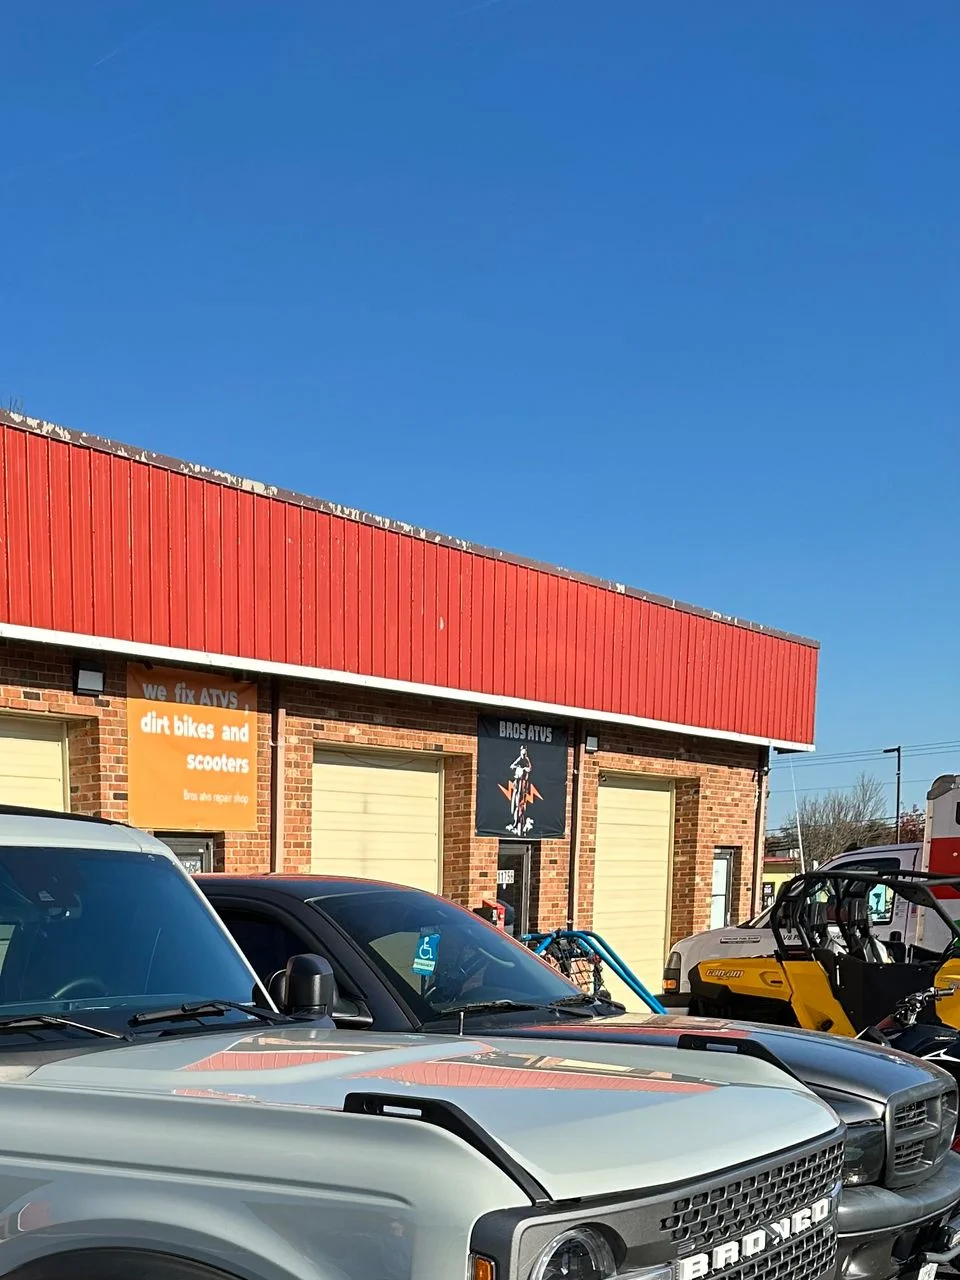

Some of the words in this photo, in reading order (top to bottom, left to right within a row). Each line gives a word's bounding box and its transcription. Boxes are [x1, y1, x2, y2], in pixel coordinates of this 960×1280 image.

[142, 682, 167, 701] we
[174, 681, 196, 705] fix
[140, 710, 170, 736] dirt
[173, 714, 215, 740] bikes
[221, 722, 249, 743] and
[499, 720, 526, 740] BROS
[186, 753, 249, 774] scooters
